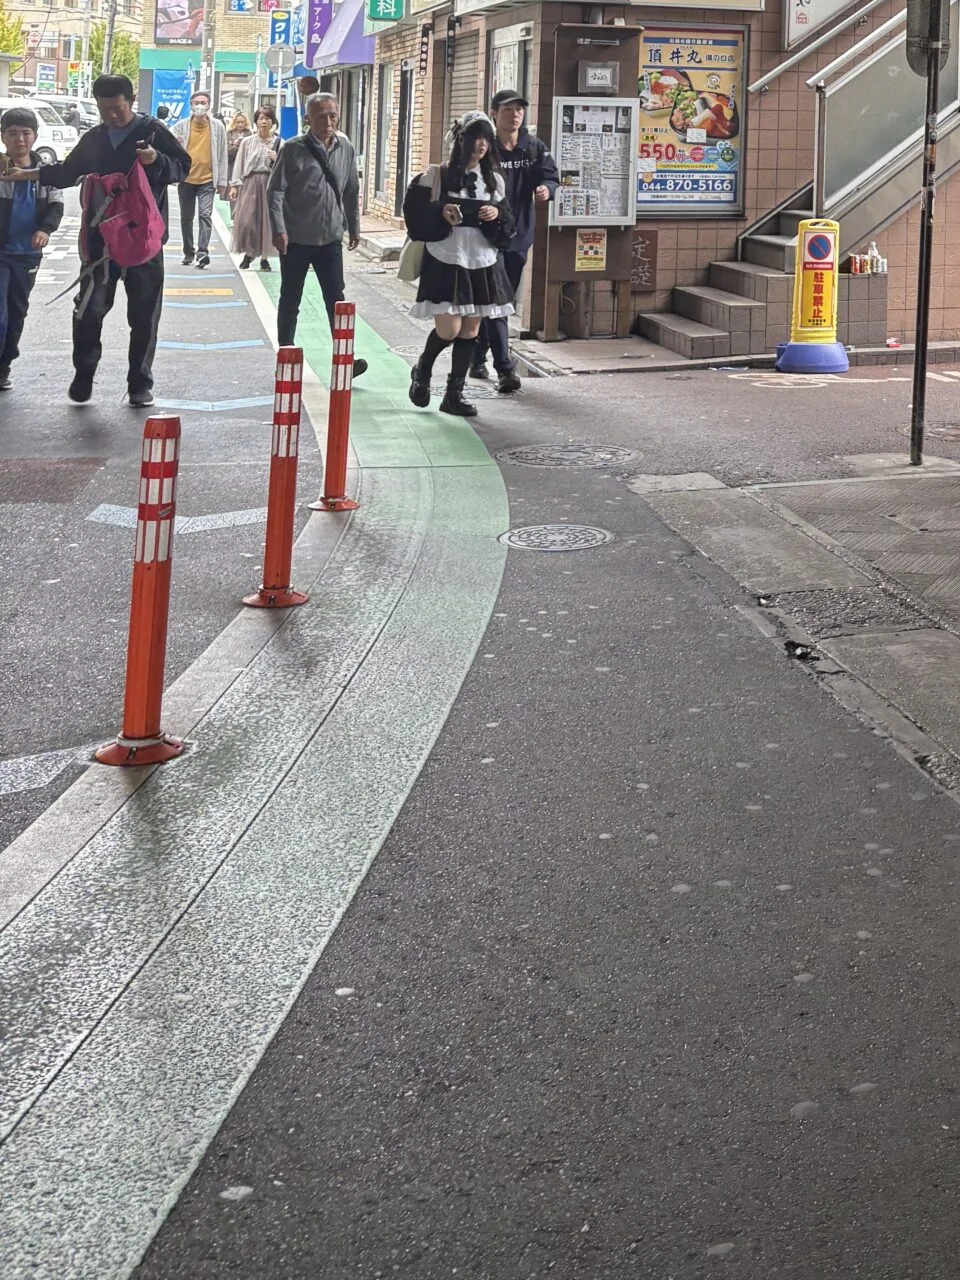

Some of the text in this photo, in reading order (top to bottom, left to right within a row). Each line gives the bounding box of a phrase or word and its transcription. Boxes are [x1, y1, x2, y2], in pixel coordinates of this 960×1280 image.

[640, 143, 676, 160] 550
[642, 179, 731, 191] 044-870-5166
[813, 271, 825, 319] 駐車禁止
